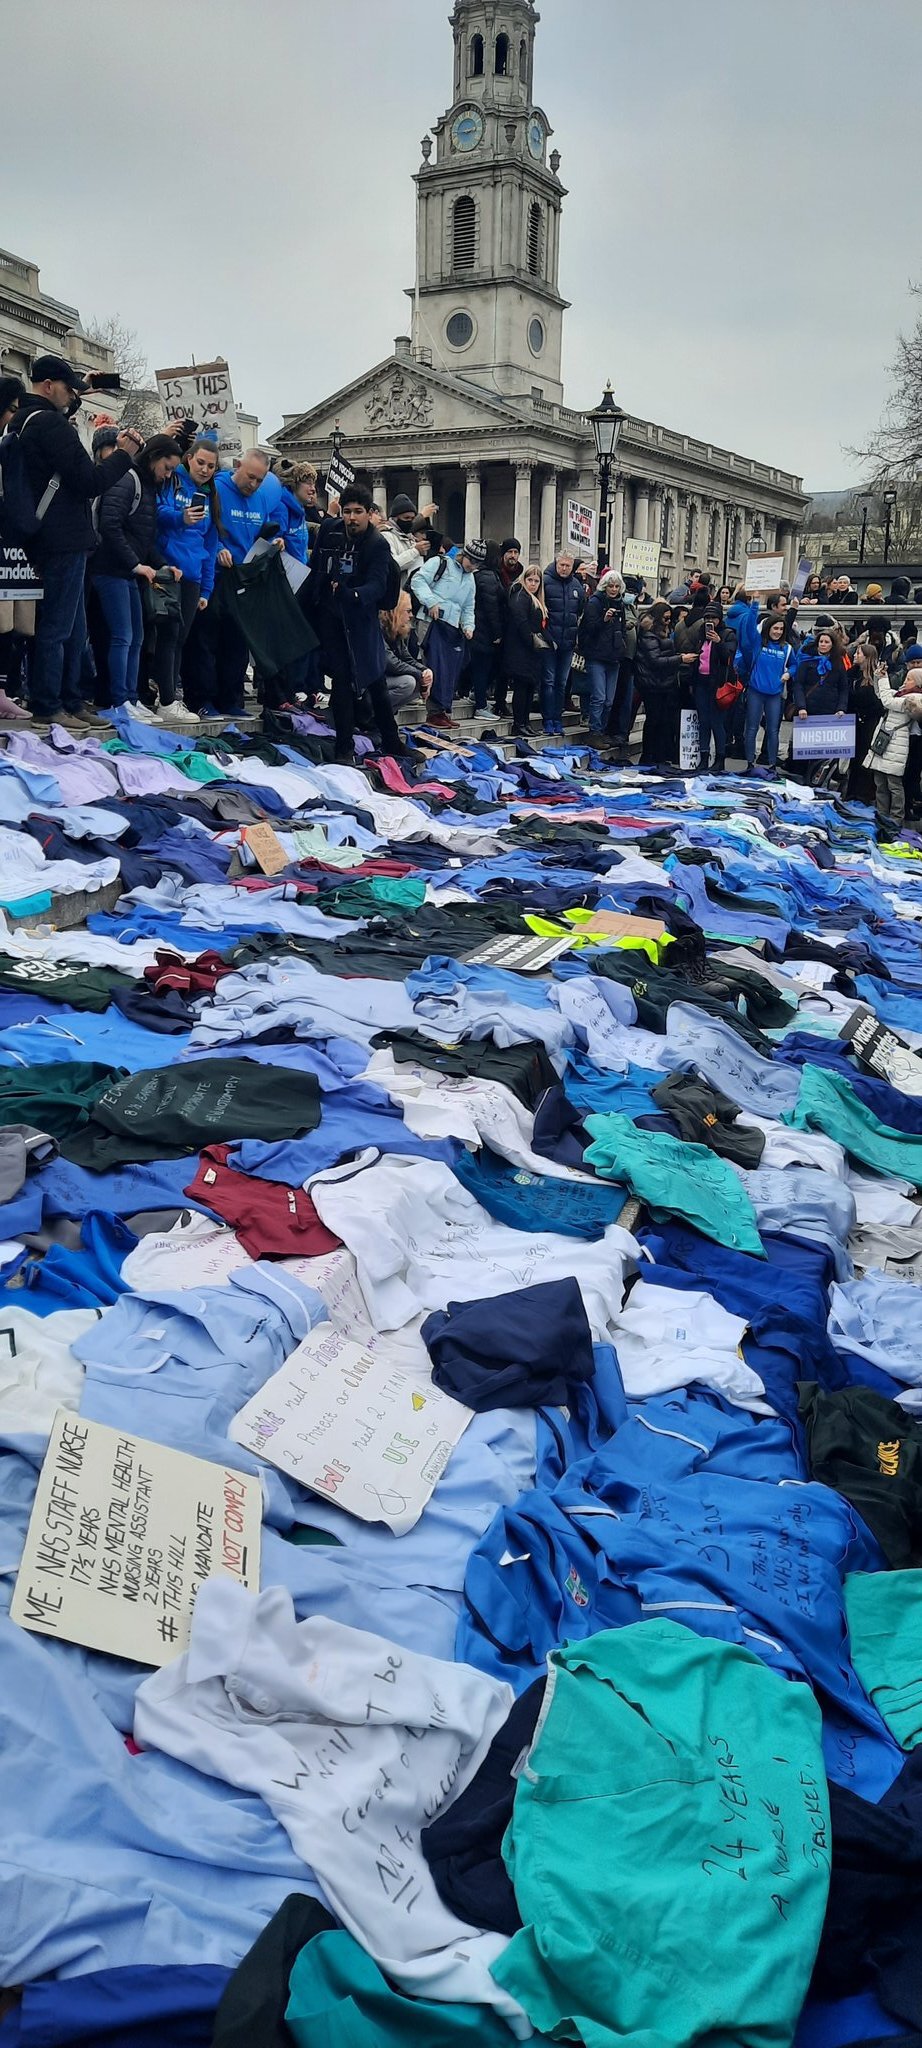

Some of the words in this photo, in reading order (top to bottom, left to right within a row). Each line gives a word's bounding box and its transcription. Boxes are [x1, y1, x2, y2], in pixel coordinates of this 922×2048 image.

[164, 380, 183, 401] IS
[193, 374, 228, 396] THIS
[165, 404, 195, 421] HOW
[200, 400, 229, 418] YOU
[332, 457, 339, 468] no
[339, 462, 355, 483] vaccine
[0, 562, 40, 580] andate
[801, 730, 848, 743] NHS100K
[465, 955, 492, 964] no
[480, 934, 525, 955] vaccine
[493, 936, 550, 966] mandates
[850, 1037, 865, 1055] no
[852, 1014, 880, 1046] vaccine
[300, 1367, 321, 1382] 2
[55, 1421, 89, 1477] NURSE
[282, 1450, 304, 1466] 2
[296, 1411, 339, 1446] Protect
[314, 1458, 351, 1494] WE
[352, 1417, 377, 1453] need
[367, 1406, 386, 1421] 2
[379, 1369, 410, 1403] STAN
[381, 1431, 420, 1466] USE
[111, 1437, 136, 1493] HEALTH
[46, 1475, 80, 1537] STAFF
[129, 1464, 153, 1541] ASSISTANT
[222, 1470, 248, 1534] COMPLY
[76, 1505, 102, 1551] YEARS
[104, 1496, 131, 1557] MENTAL
[193, 1501, 214, 1580] MANDATE
[35, 1533, 71, 1578] NHS
[122, 1542, 144, 1603] NURSING
[144, 1547, 164, 1590] YEARS
[169, 1534, 187, 1572] HILL
[221, 1529, 243, 1575] NOT
[97, 1556, 123, 1596] NHS
[162, 1571, 185, 1612] THIS
[773, 1557, 793, 1592] NHS
[142, 1590, 157, 1606] 2
[374, 1655, 403, 1684] be
[707, 1735, 748, 1823] YEARS
[701, 1838, 760, 1881] 24
[758, 1797, 797, 1883] NURSE
[770, 1893, 791, 1921] A
